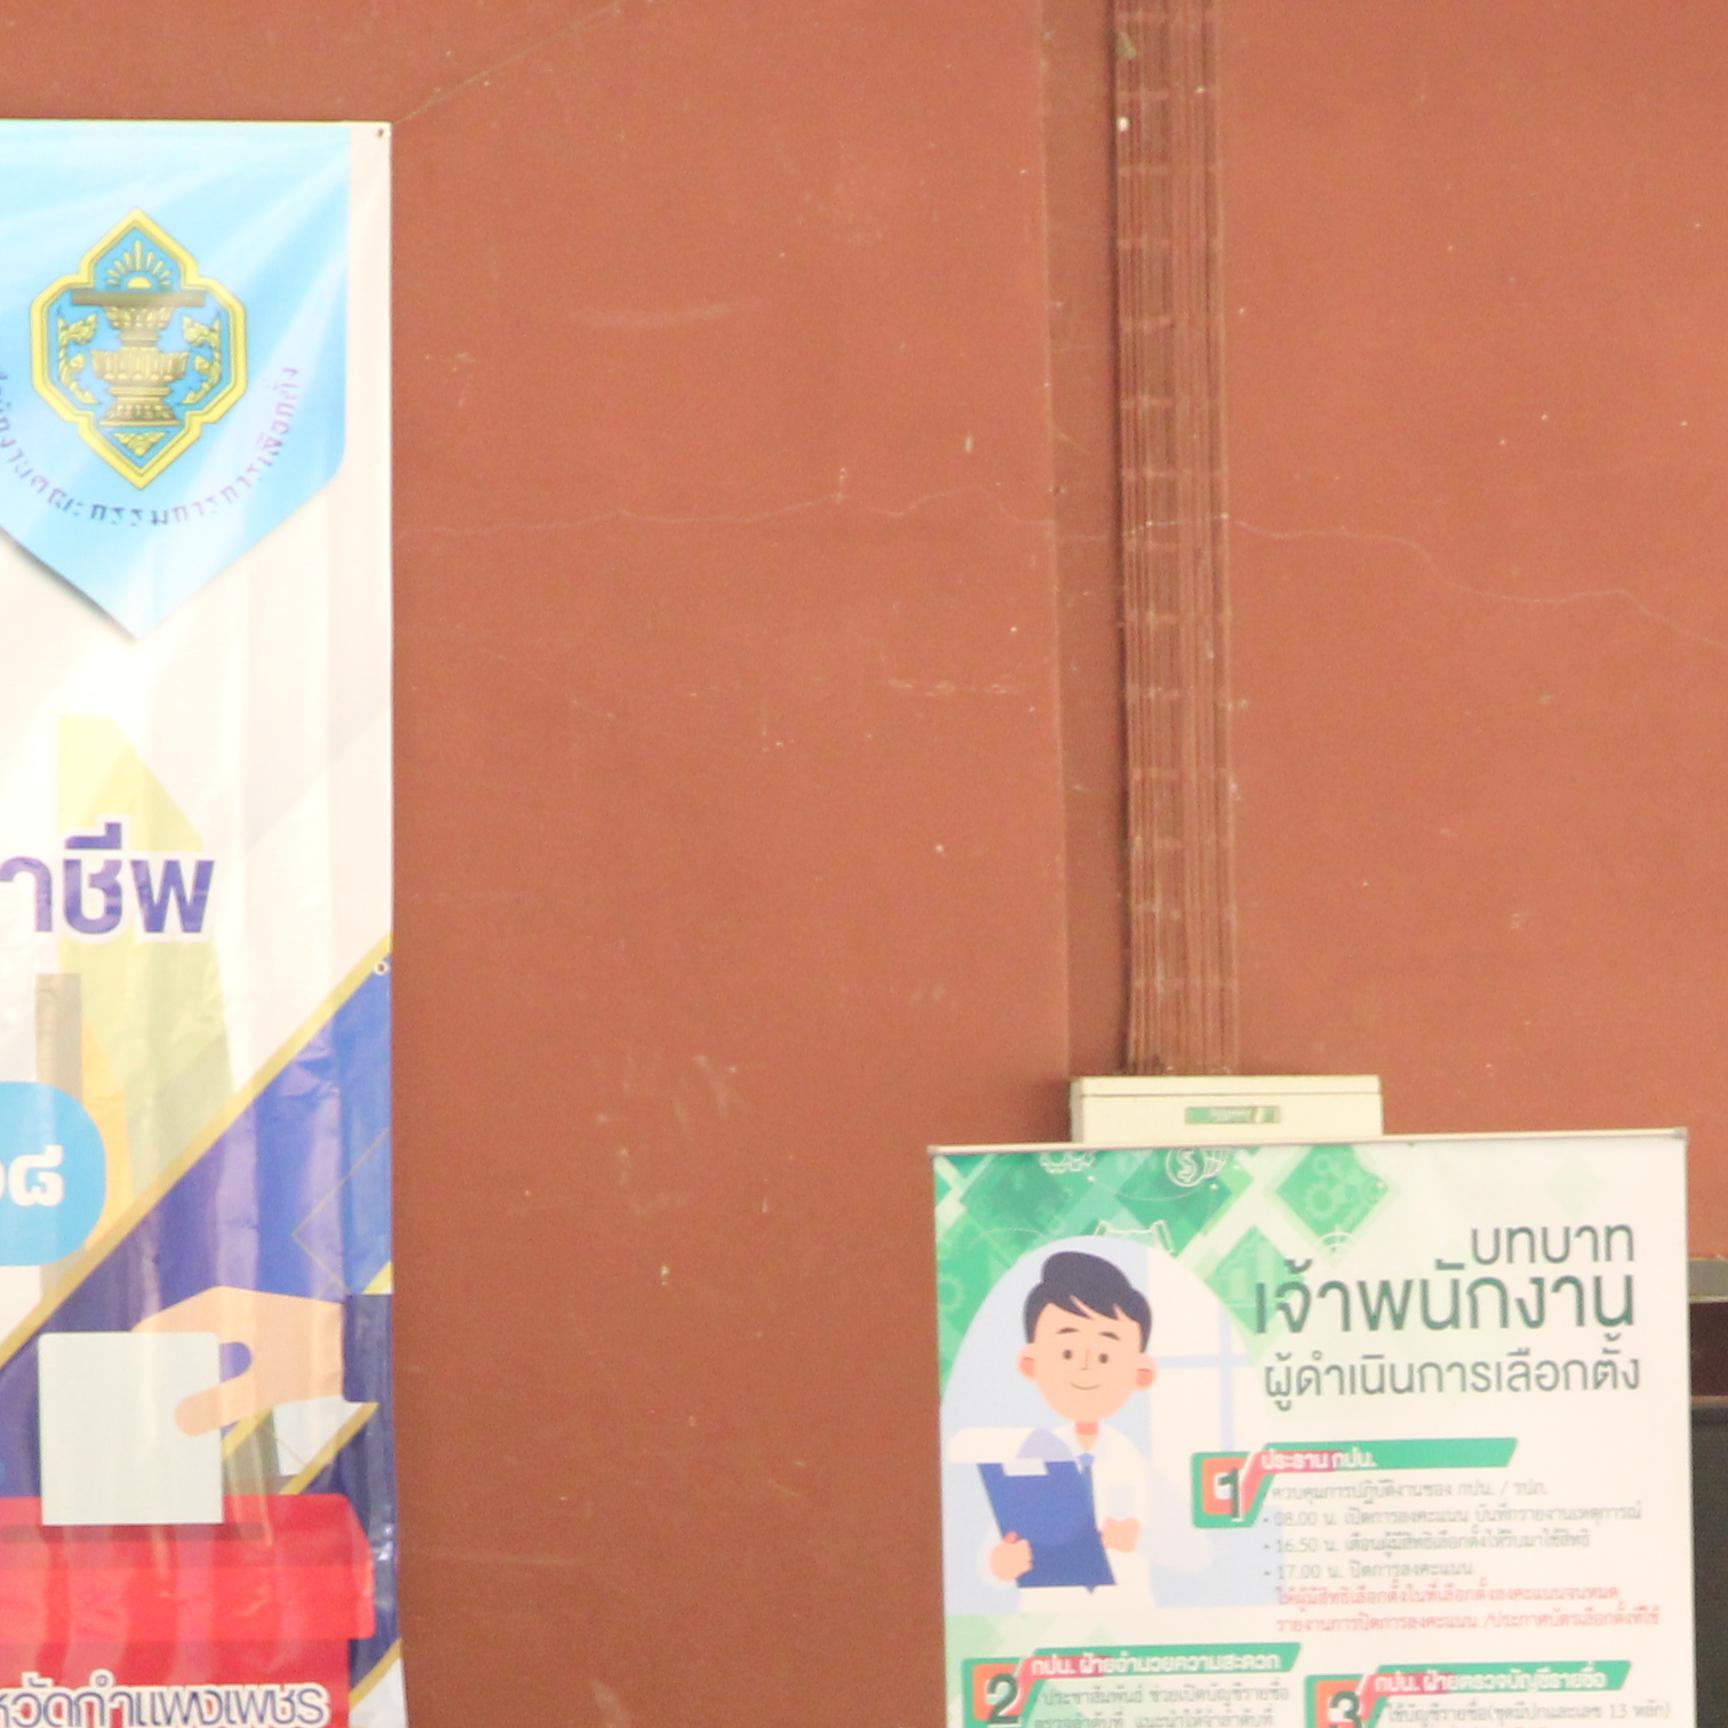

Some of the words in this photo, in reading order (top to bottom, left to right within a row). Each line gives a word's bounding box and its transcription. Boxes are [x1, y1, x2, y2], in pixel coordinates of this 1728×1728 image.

[1471, 1224, 1635, 1266] บทบาท
[1254, 1258, 1635, 1334] เจ้าพนักงาน
[1265, 1332, 1640, 1412] ผู้ดำเนินการเลือกตั้ง
[1218, 1468, 1243, 1522] 1
[1262, 1448, 1327, 1470] ประธาน
[1332, 1446, 1377, 1469] กปน.
[1274, 1509, 1318, 1527] 08.00
[1276, 1536, 1319, 1553] 16.50
[1276, 1563, 1321, 1580] 17.00
[986, 1673, 1020, 1726] 2
[1030, 1655, 1077, 1676] กปน.
[1080, 1649, 1281, 1675] ฝ่ายอำนวยความสะดวก
[1374, 1671, 1418, 1692] กปน.
[1610, 1703, 1628, 1720] 13
